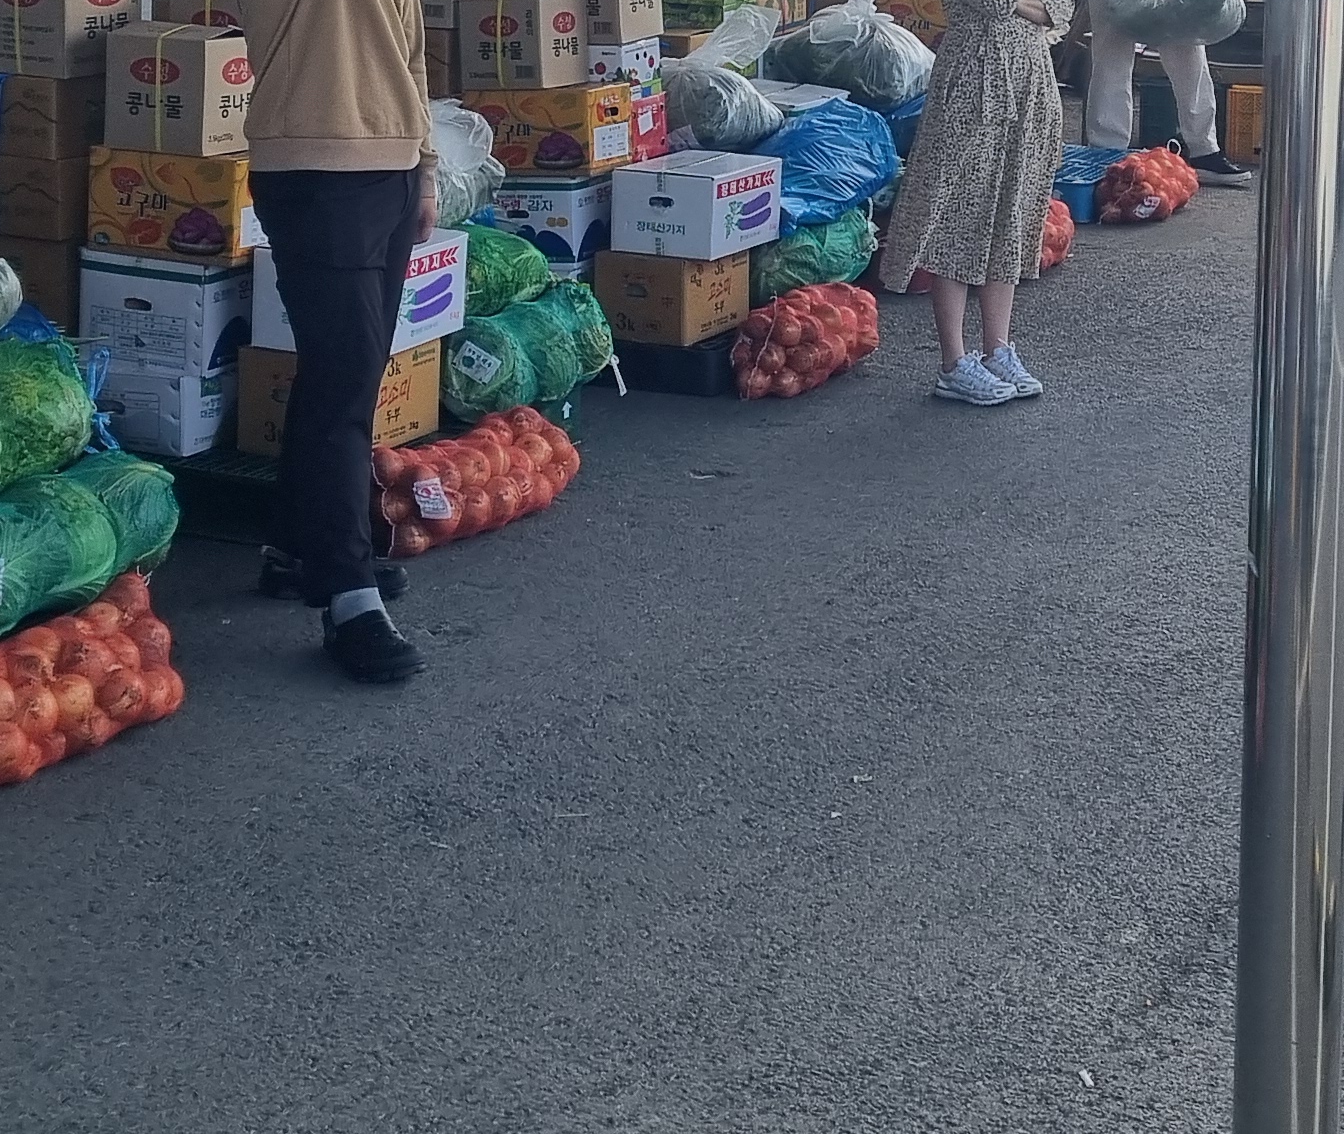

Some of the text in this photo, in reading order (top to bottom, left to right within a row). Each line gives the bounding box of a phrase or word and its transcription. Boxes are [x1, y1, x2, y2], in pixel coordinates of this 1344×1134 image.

[552, 37, 579, 57] 콩나물
[527, 199, 553, 212] 감자
[636, 220, 686, 236] 장태산가지
[385, 406, 401, 425] 두부
